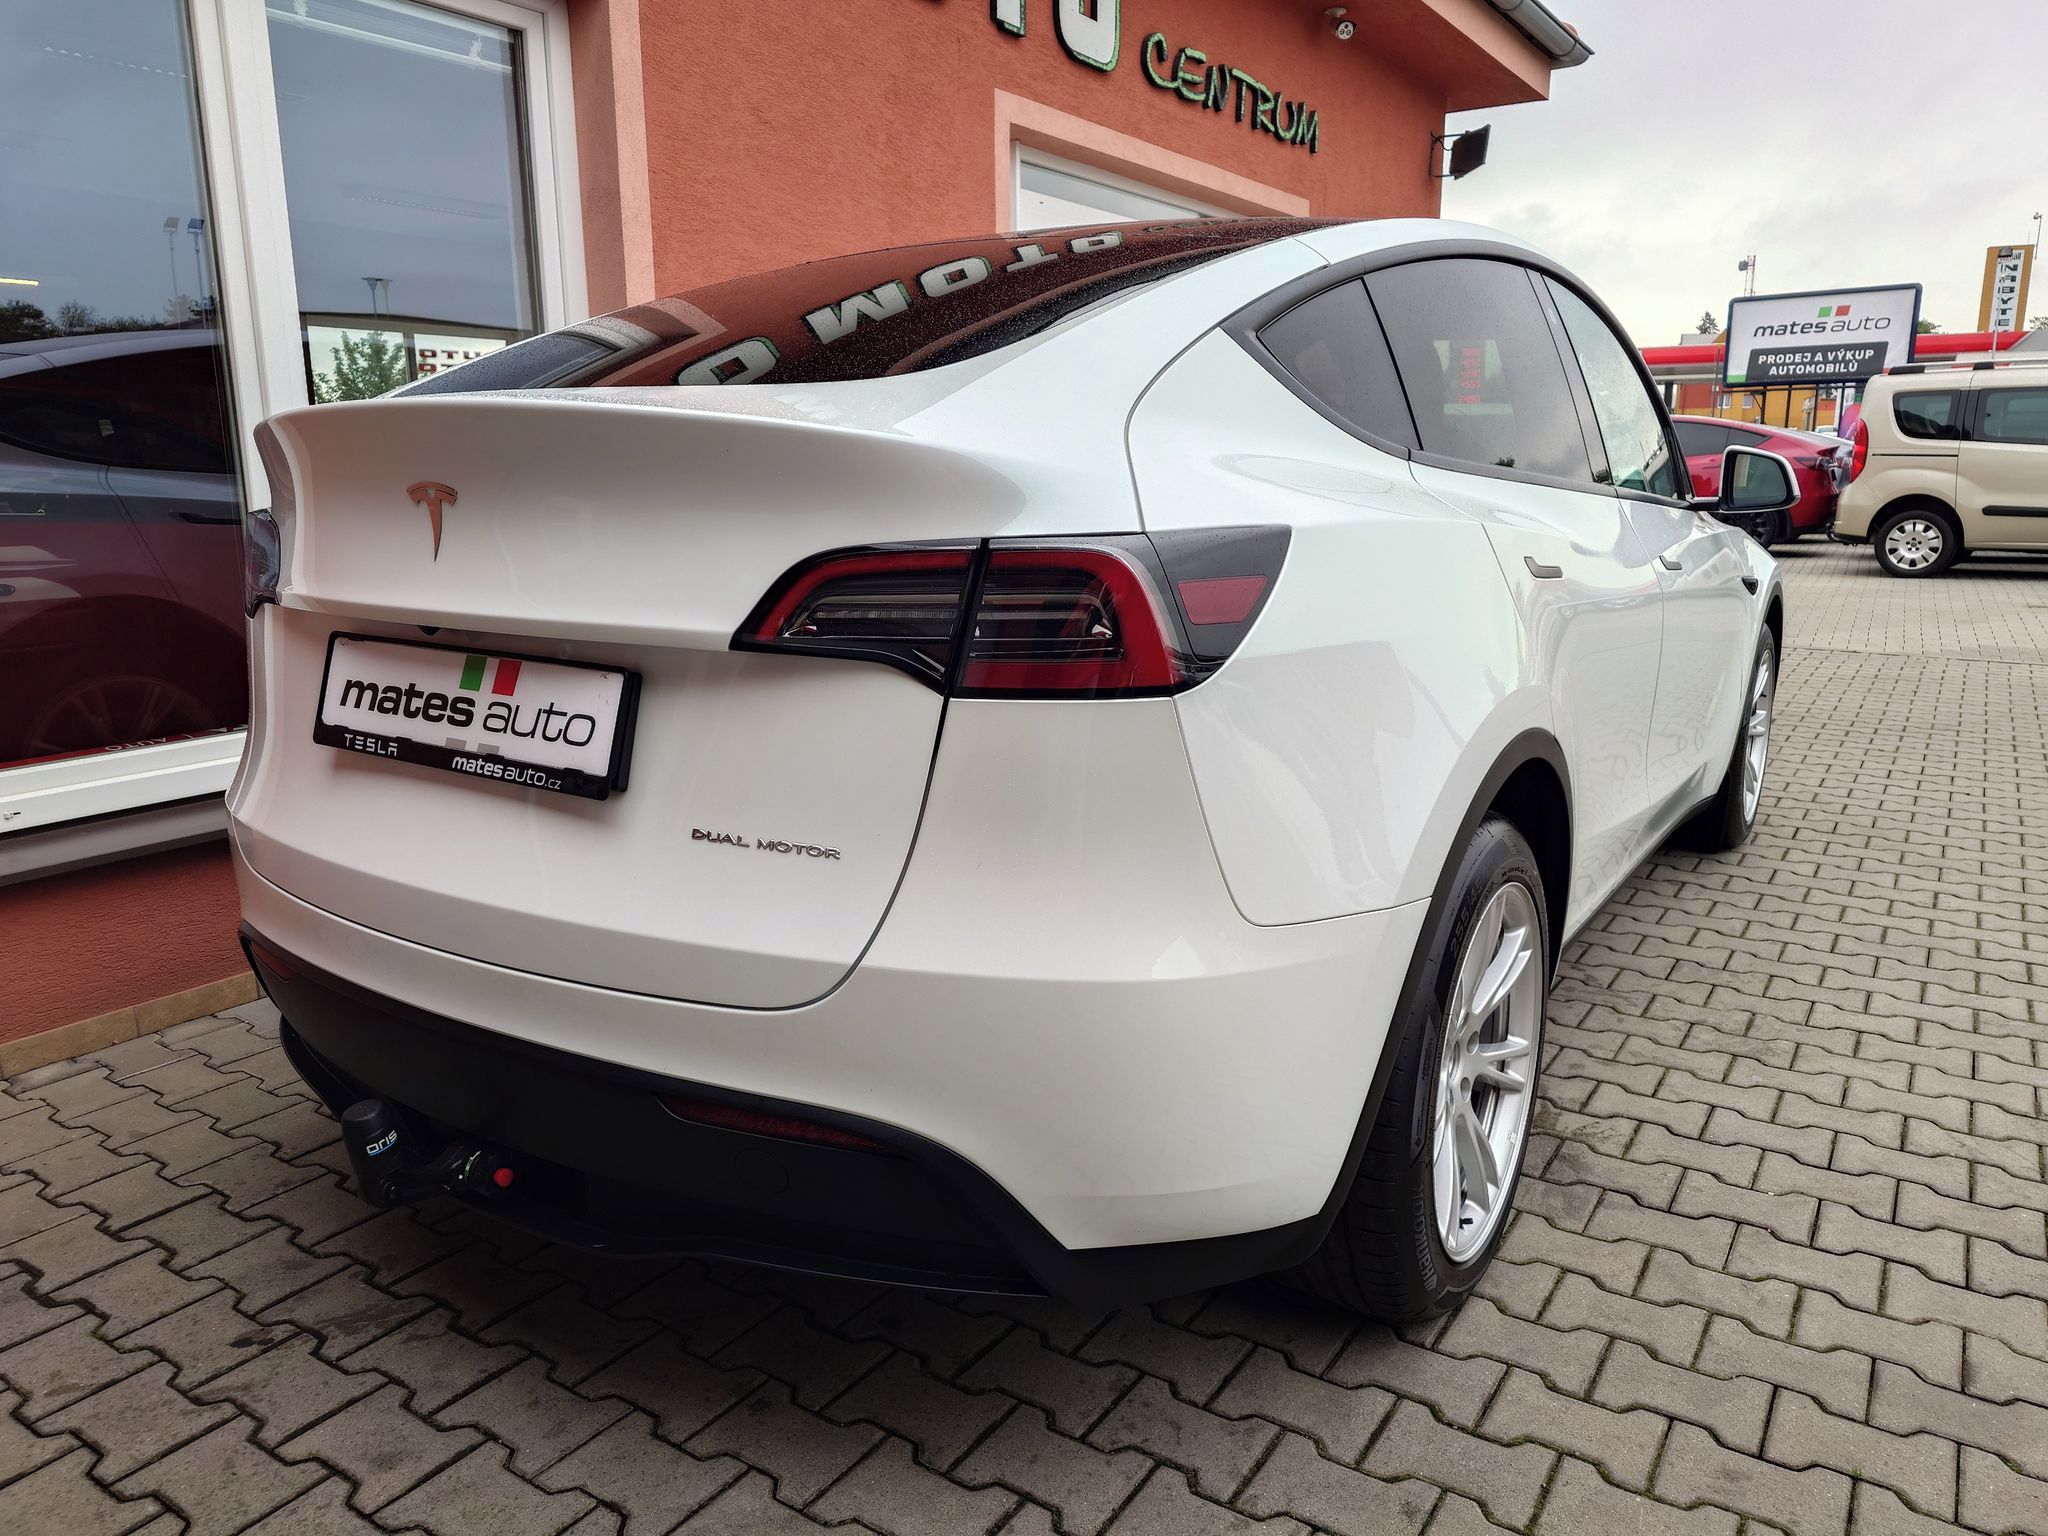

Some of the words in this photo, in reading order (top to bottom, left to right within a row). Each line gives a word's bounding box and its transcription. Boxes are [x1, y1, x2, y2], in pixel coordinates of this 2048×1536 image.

[1141, 32, 1318, 154] CENTRUM
[1753, 321, 1828, 337] mates
[1830, 316, 1891, 332] auto
[1758, 351, 1813, 365] PRODEJ
[1814, 351, 1823, 362] A
[1827, 348, 1875, 362] VÝKUP
[1768, 360, 1859, 377] AUTOMOBILŮ
[339, 678, 476, 728] mates
[482, 701, 596, 747] auto
[344, 733, 399, 757] TESLA
[452, 756, 562, 790] matesauto.cz
[691, 828, 750, 848] DUAL
[757, 838, 841, 860] MOTOR
